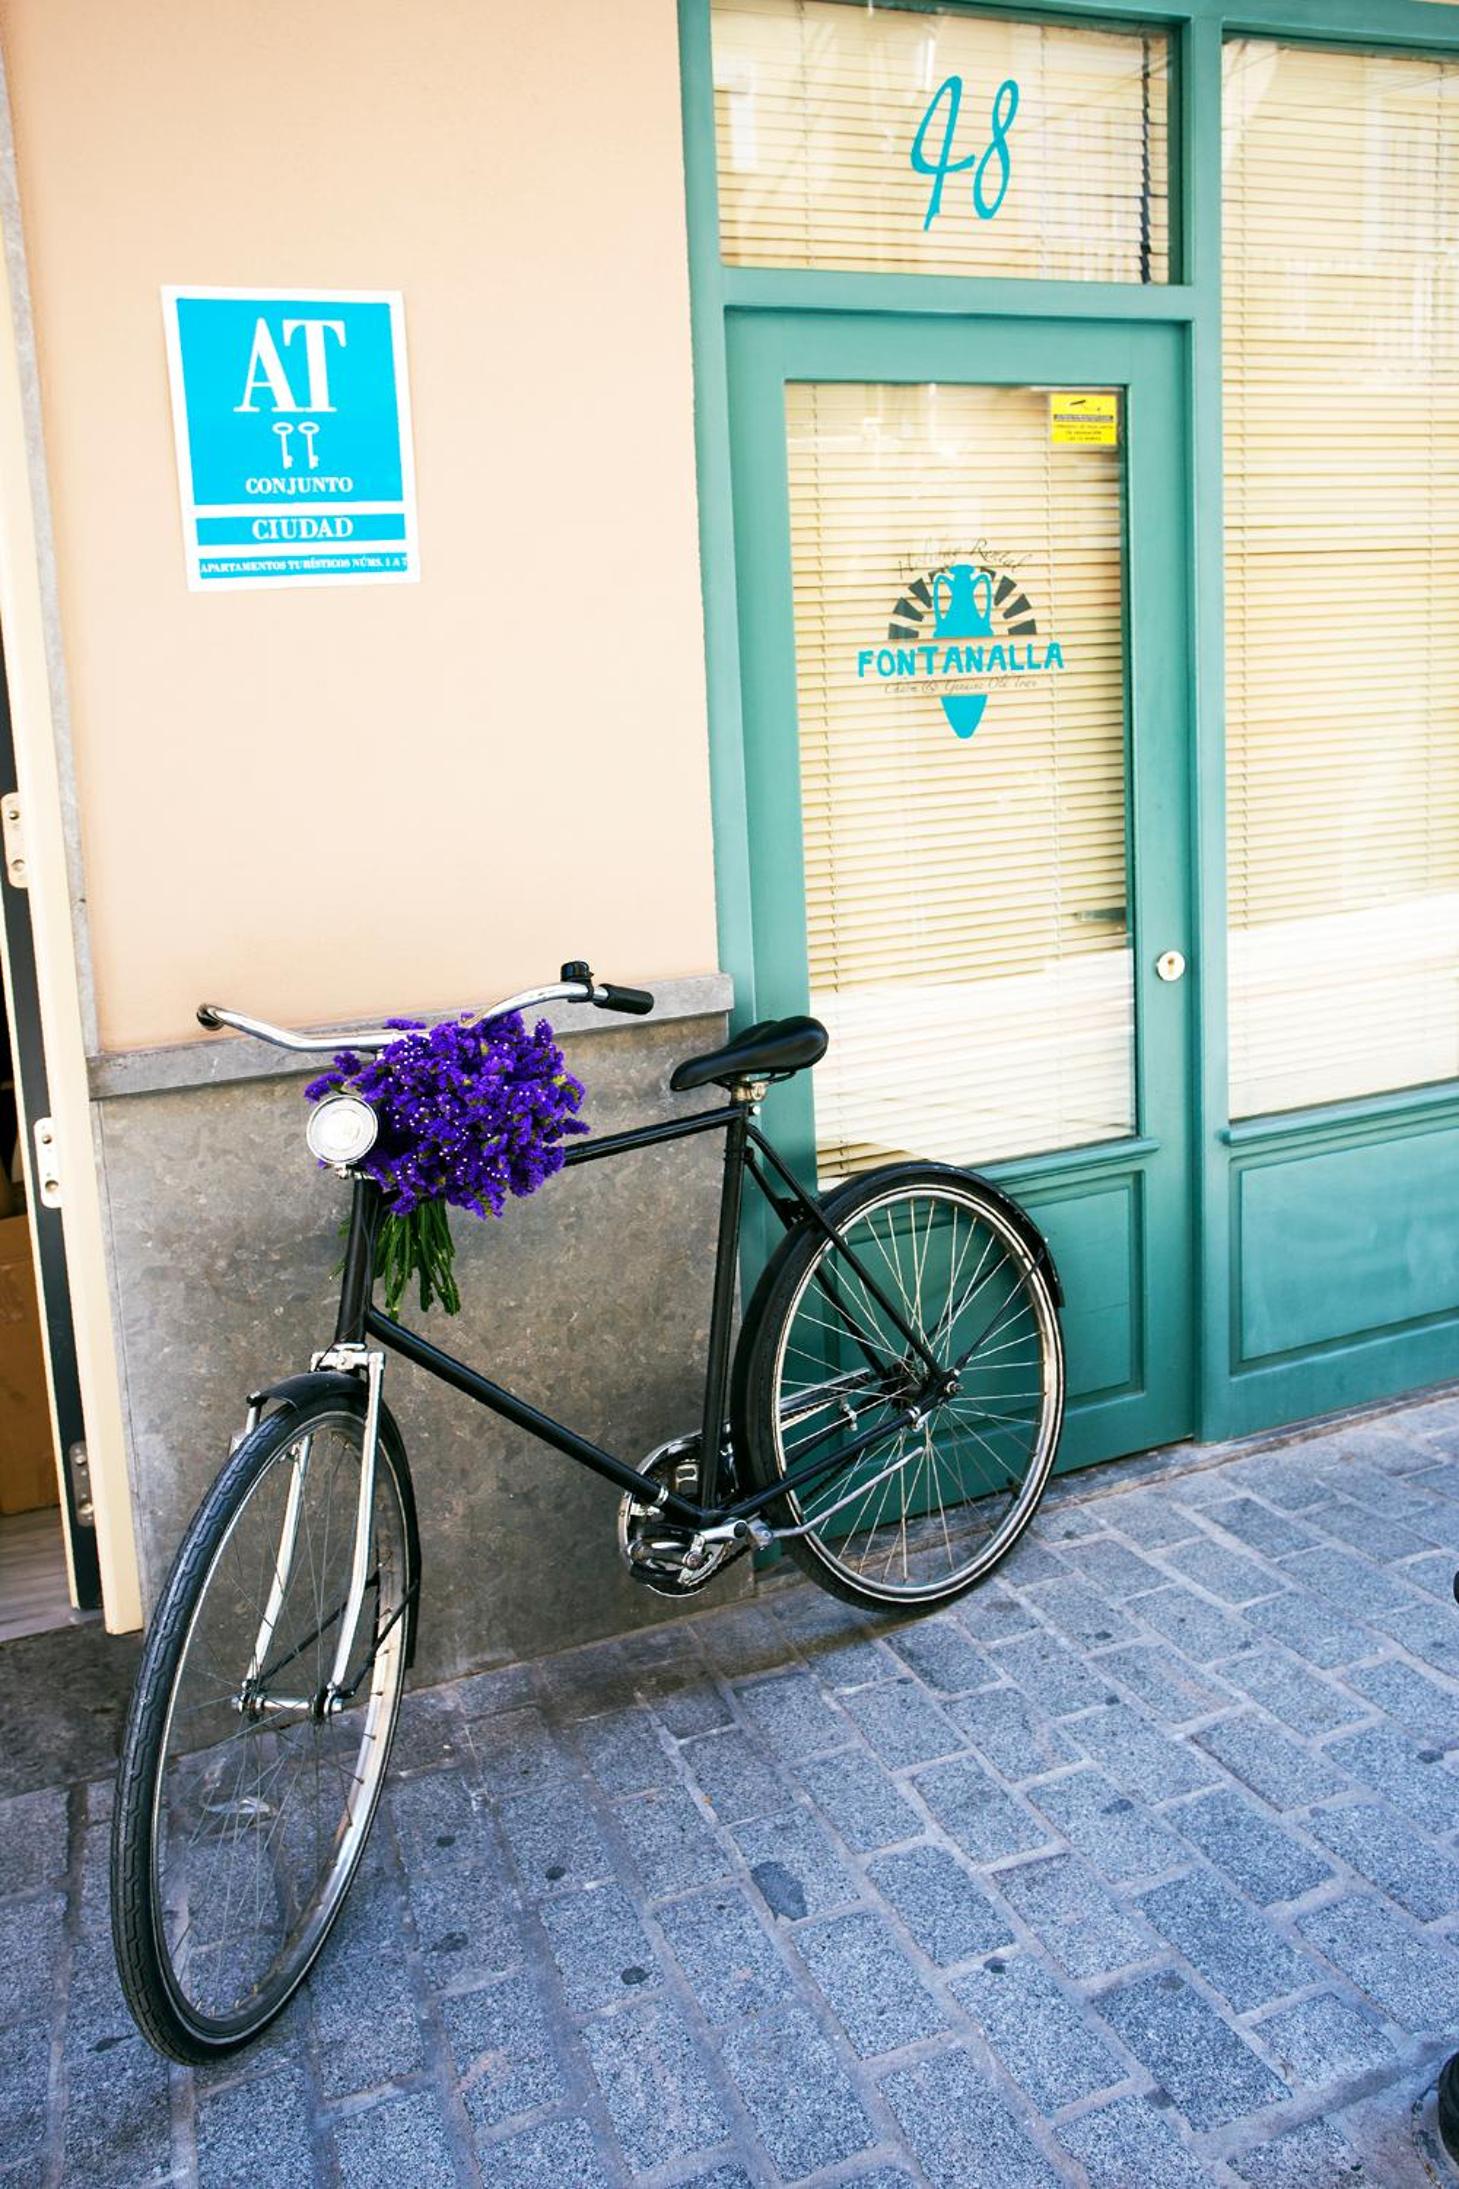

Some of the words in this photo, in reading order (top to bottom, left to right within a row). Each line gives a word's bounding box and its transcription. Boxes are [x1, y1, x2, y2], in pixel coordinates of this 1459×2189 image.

[910, 74, 1019, 231] 48
[232, 317, 347, 412] AT
[245, 476, 354, 495] CONJUNTO
[251, 517, 354, 540] CIUDAD
[201, 560, 286, 574] APARTAMENTOS
[393, 557, 401, 567] A
[858, 643, 1065, 677] FONTANALLA
